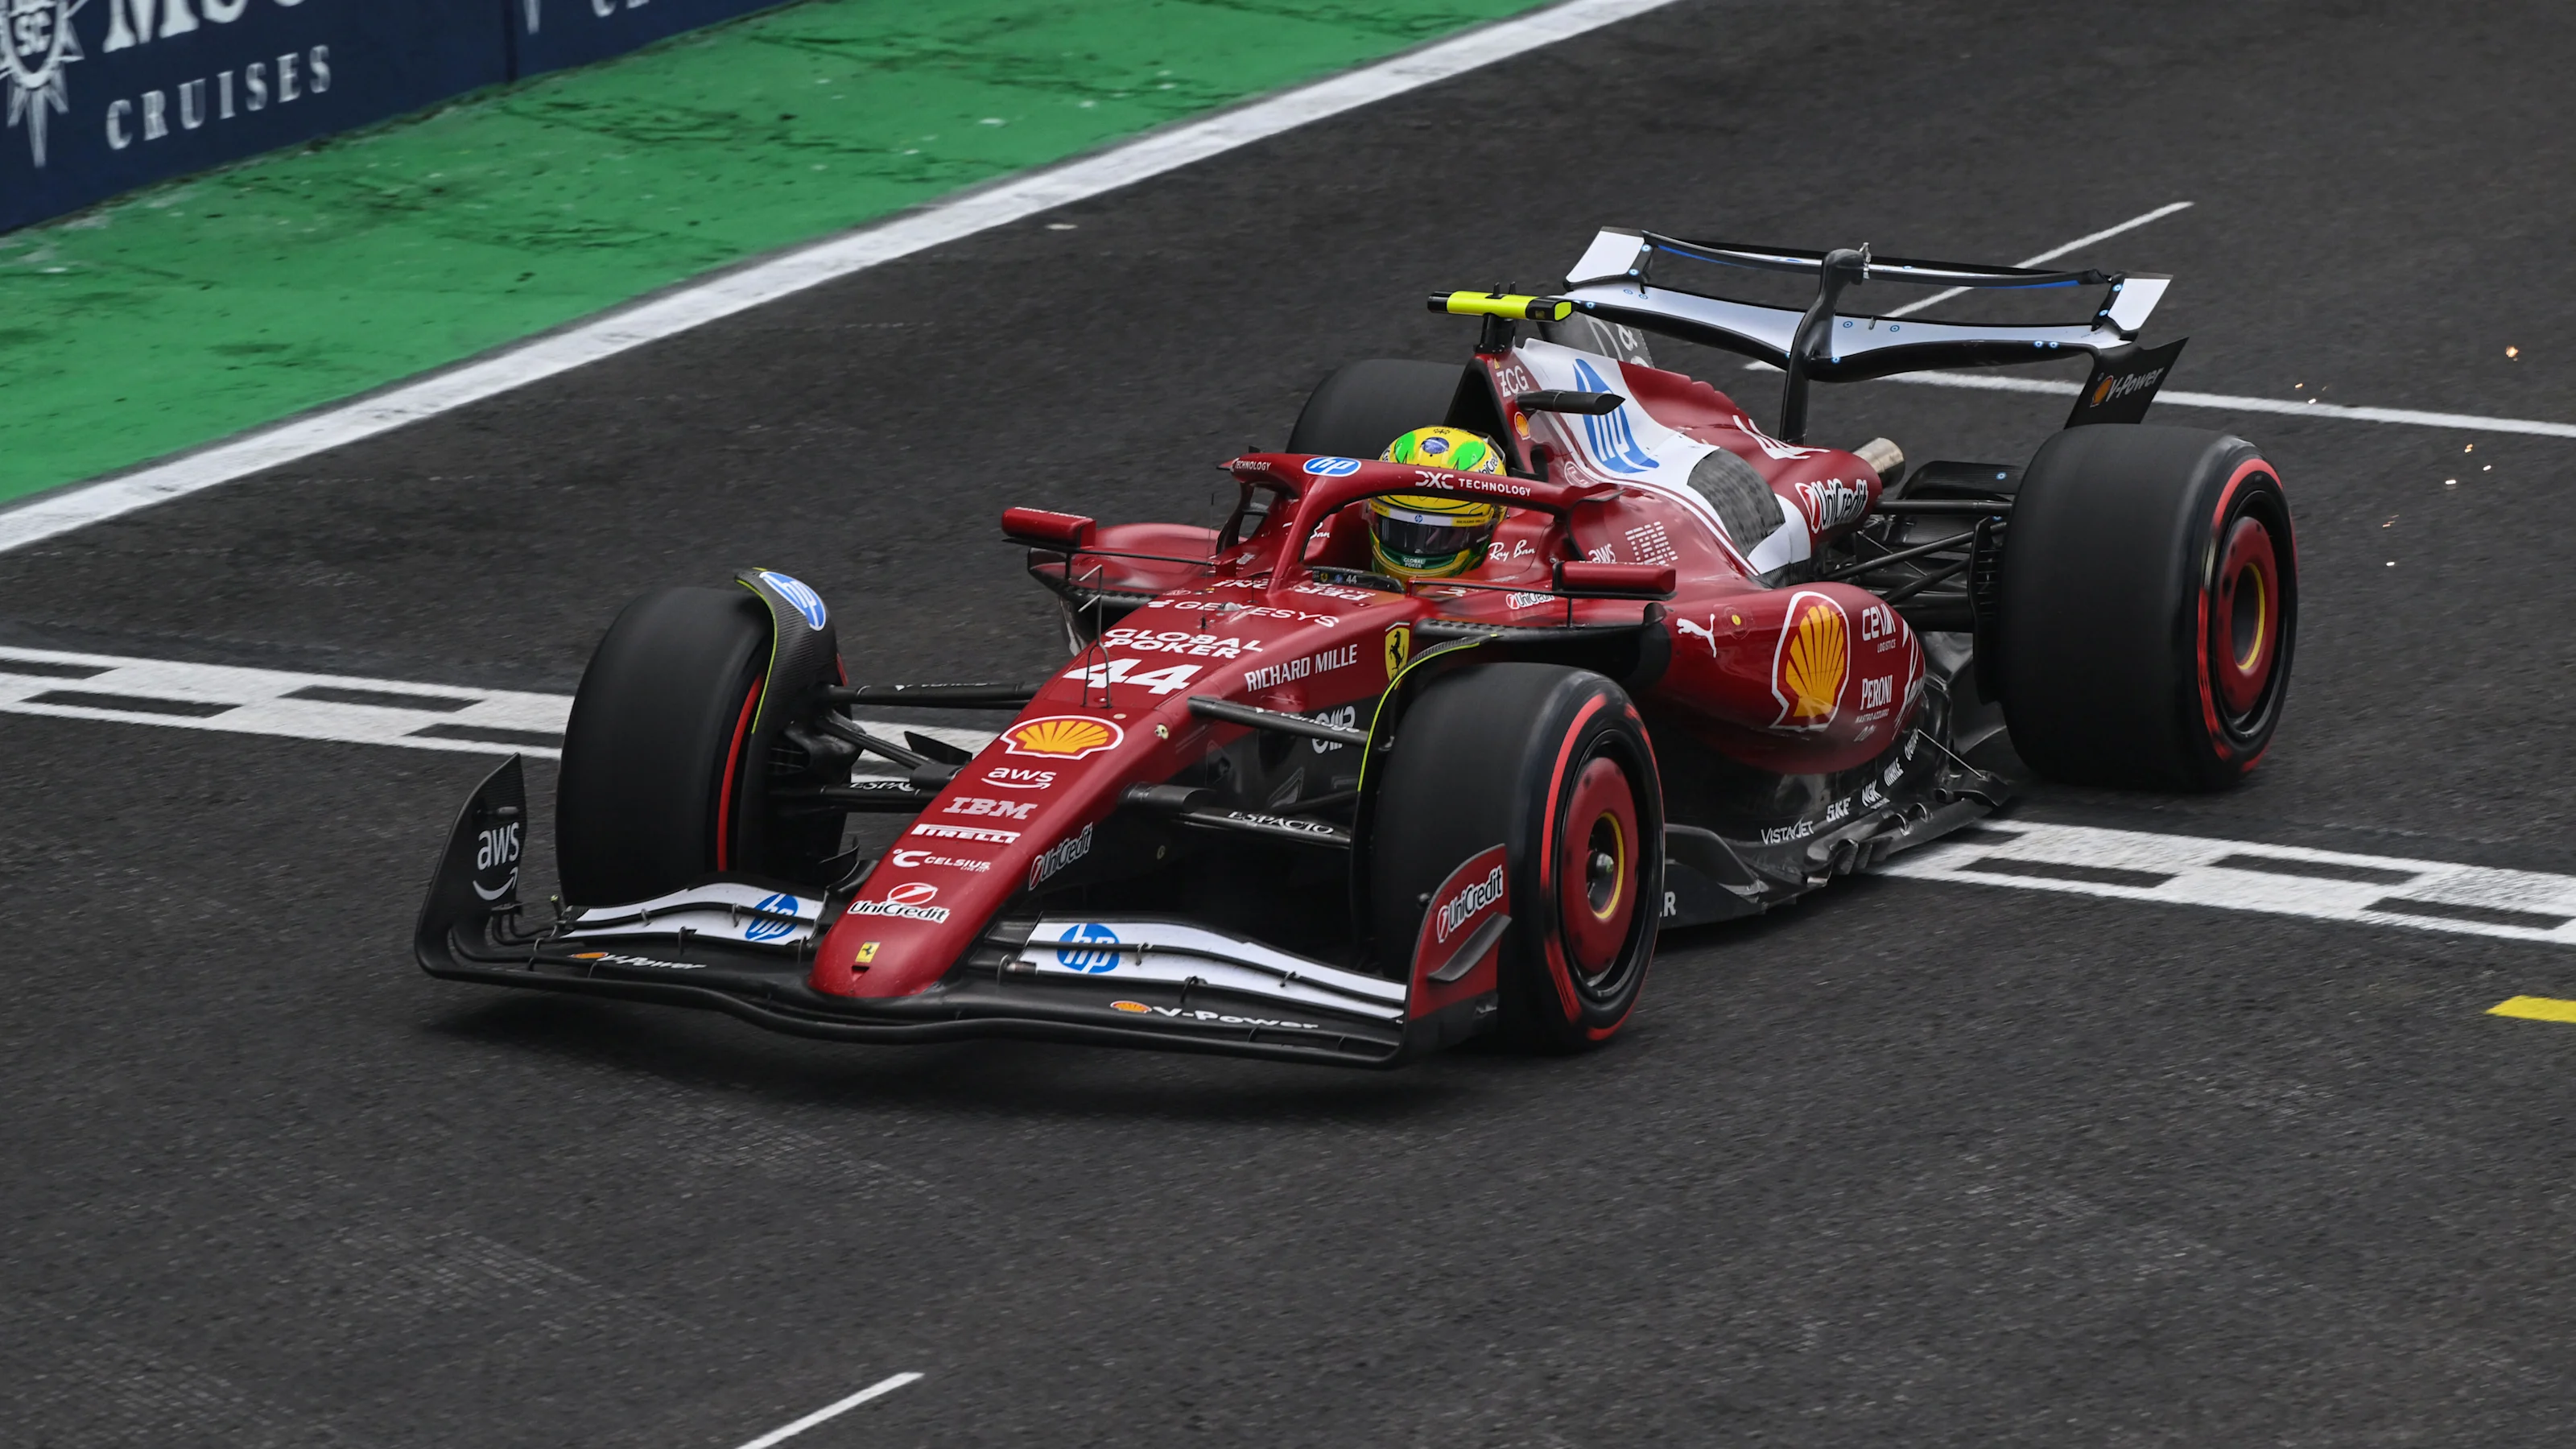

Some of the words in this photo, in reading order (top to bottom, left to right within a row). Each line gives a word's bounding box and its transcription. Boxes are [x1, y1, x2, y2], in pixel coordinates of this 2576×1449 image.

[106, 45, 331, 150] CRUISES
[2105, 367, 2165, 402] V-Power
[1234, 460, 1271, 472] TECHNOLOGY
[1308, 456, 1357, 476] hp
[1414, 470, 1454, 490] DXC
[1458, 477, 1531, 497] TECHNOLOGY
[1810, 478, 1868, 530] UniCredit
[1487, 542, 1510, 562] Ray
[1513, 539, 1536, 559] Ban
[1588, 543, 1616, 564] aws
[1345, 574, 1358, 584] 44
[1862, 603, 1897, 642] CEVA
[1104, 628, 1265, 653] GLOBAL
[1104, 638, 1241, 659] POKER
[1876, 638, 1897, 654] LOGISTICS
[1062, 658, 1203, 696] 44
[1244, 656, 1311, 693] RICHARD
[1315, 643, 1358, 675] MILLE
[1860, 675, 1893, 711] PERONI
[988, 767, 1057, 782] aws
[1861, 779, 1882, 807] NGK
[943, 796, 1038, 820] IBM
[1826, 796, 1852, 823] SKF
[910, 824, 1022, 844] PIRELLI
[1228, 811, 1334, 835] ESPACIO
[477, 822, 520, 871] aws
[924, 856, 992, 870] CELSIUS
[1449, 865, 1503, 931] UniCredit
[747, 894, 797, 940] hp
[848, 901, 950, 923] UniCredit
[1060, 923, 1118, 973] hp
[597, 954, 707, 970] V-Power
[1153, 1006, 1319, 1029] V-Power
